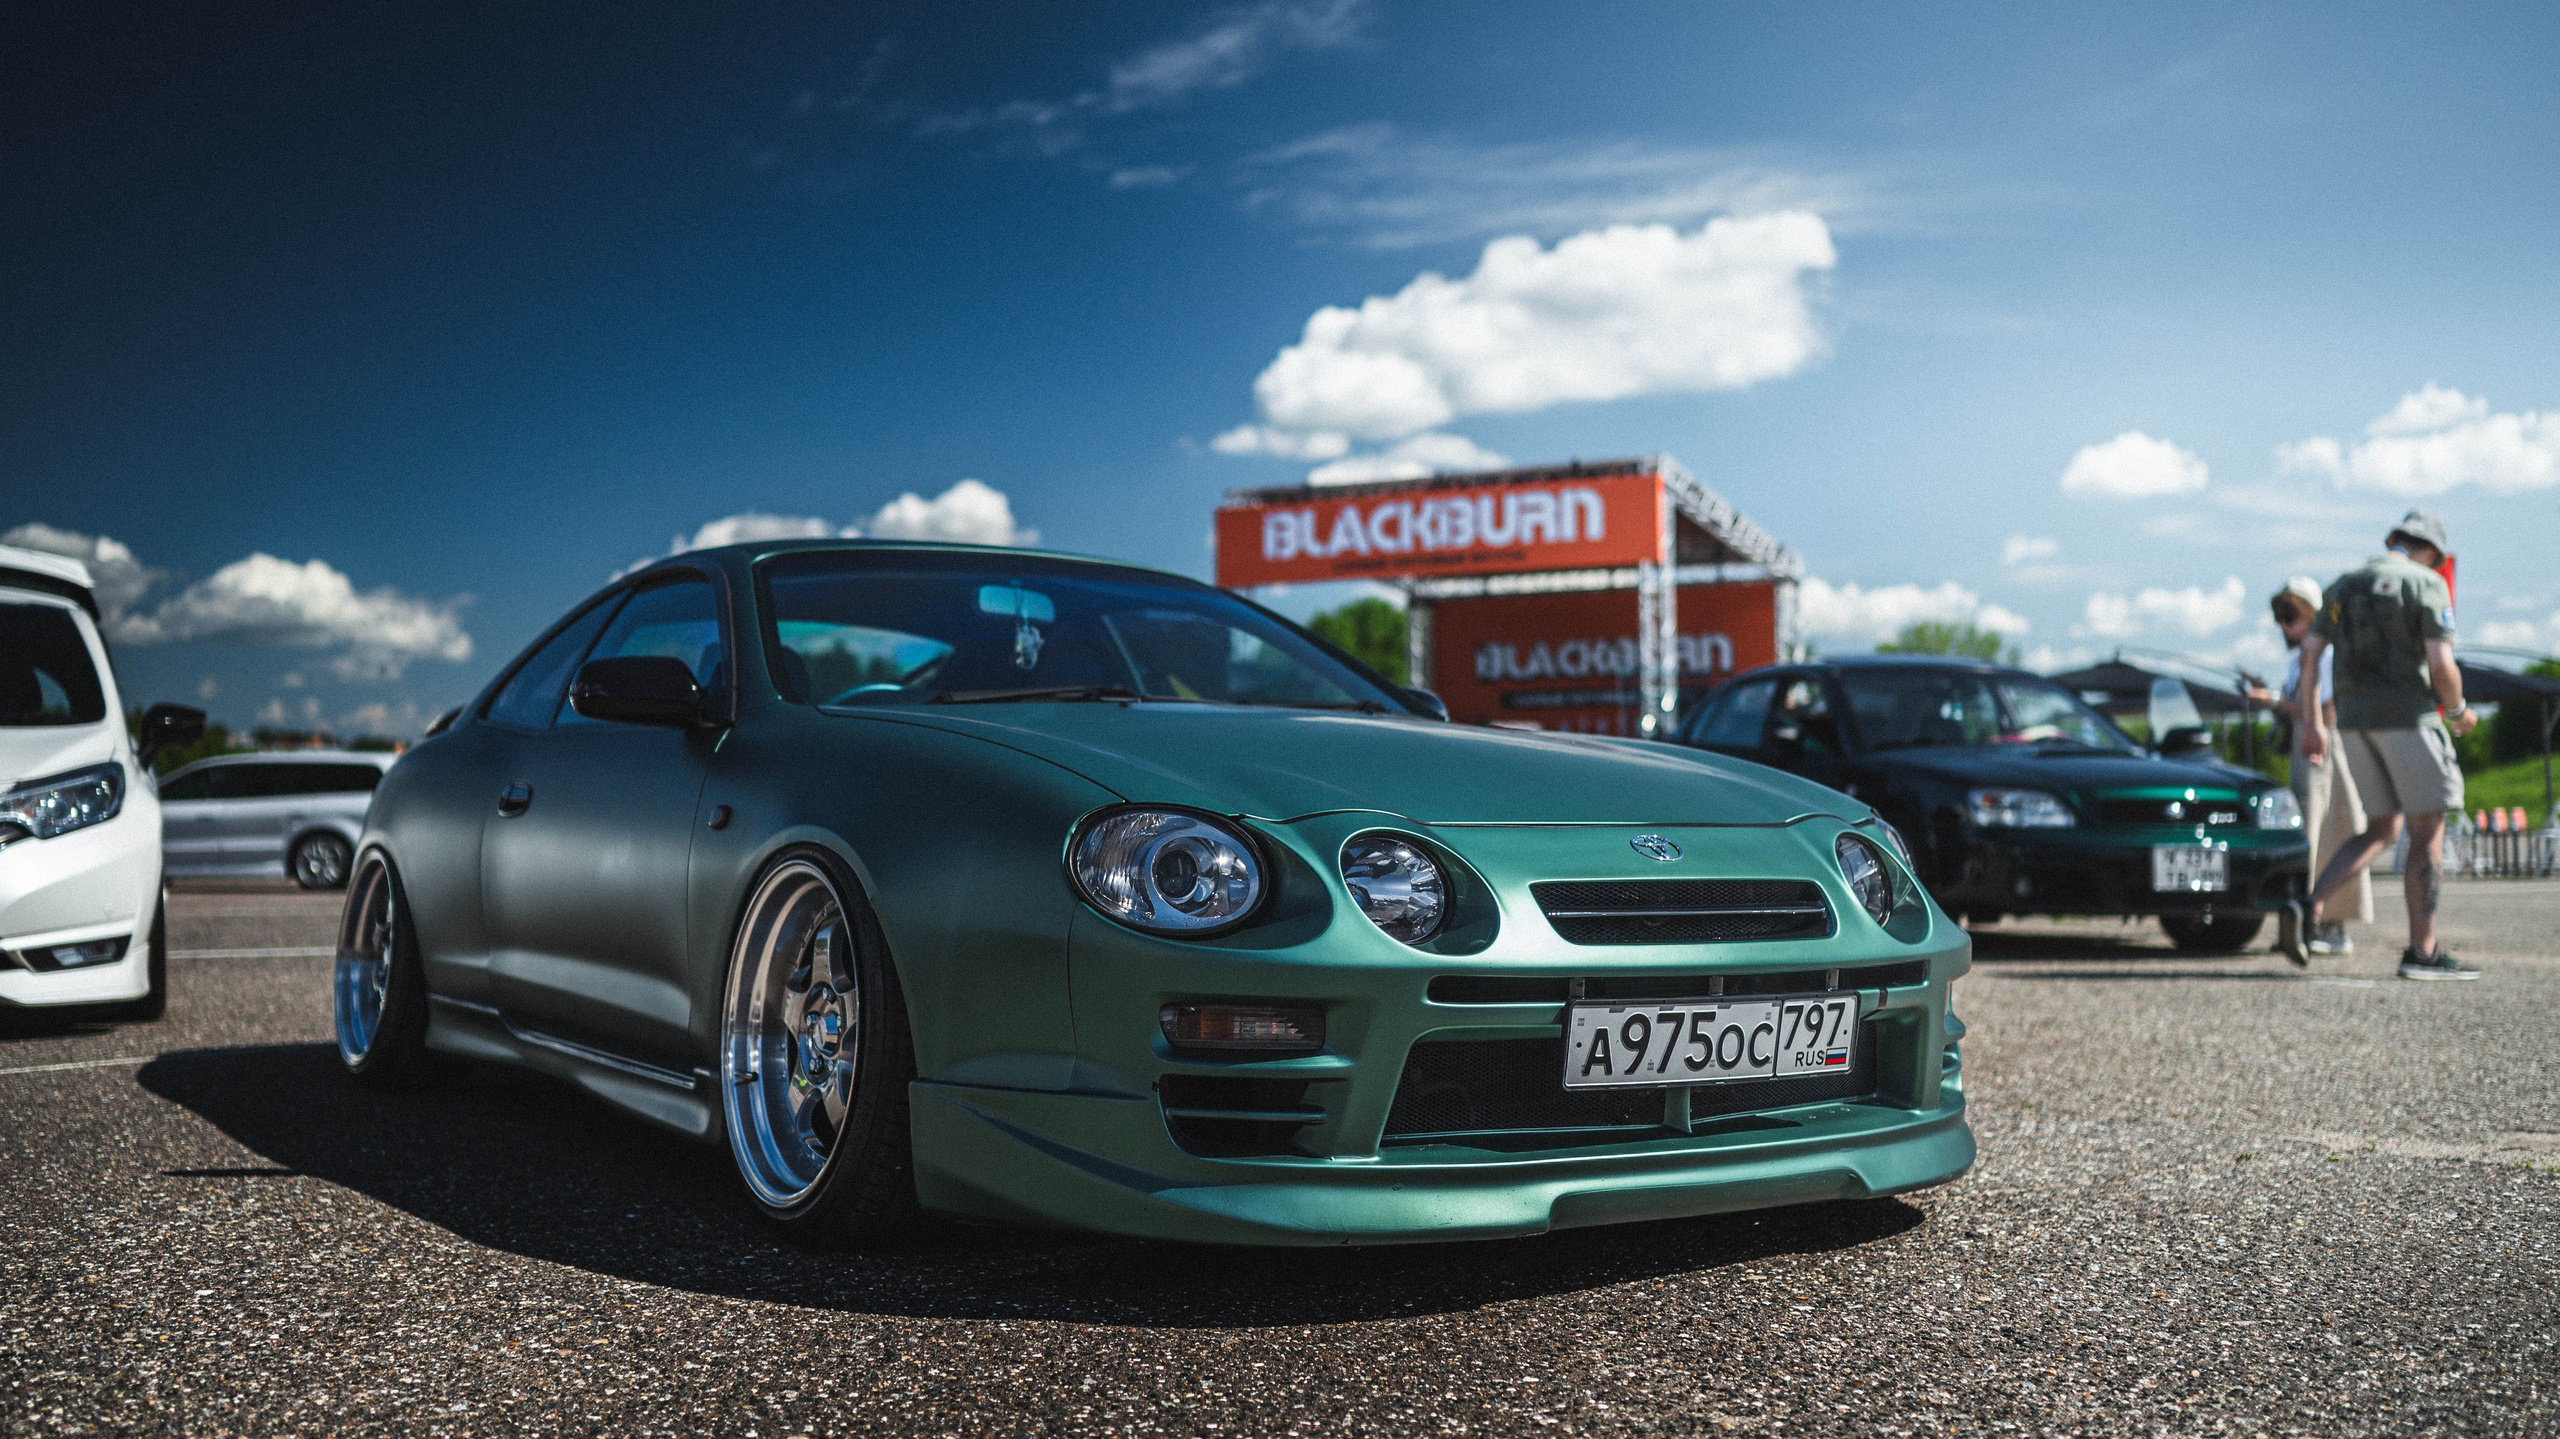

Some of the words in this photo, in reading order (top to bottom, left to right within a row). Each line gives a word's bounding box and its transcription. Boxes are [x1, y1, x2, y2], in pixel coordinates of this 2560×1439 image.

[1264, 489, 1604, 560] BLACKBURN
[1476, 634, 1733, 679] BLACKBRN
[1582, 1011, 1775, 1076] A975OC
[1784, 1002, 1846, 1050] 797
[1795, 1049, 1824, 1068] RUS
